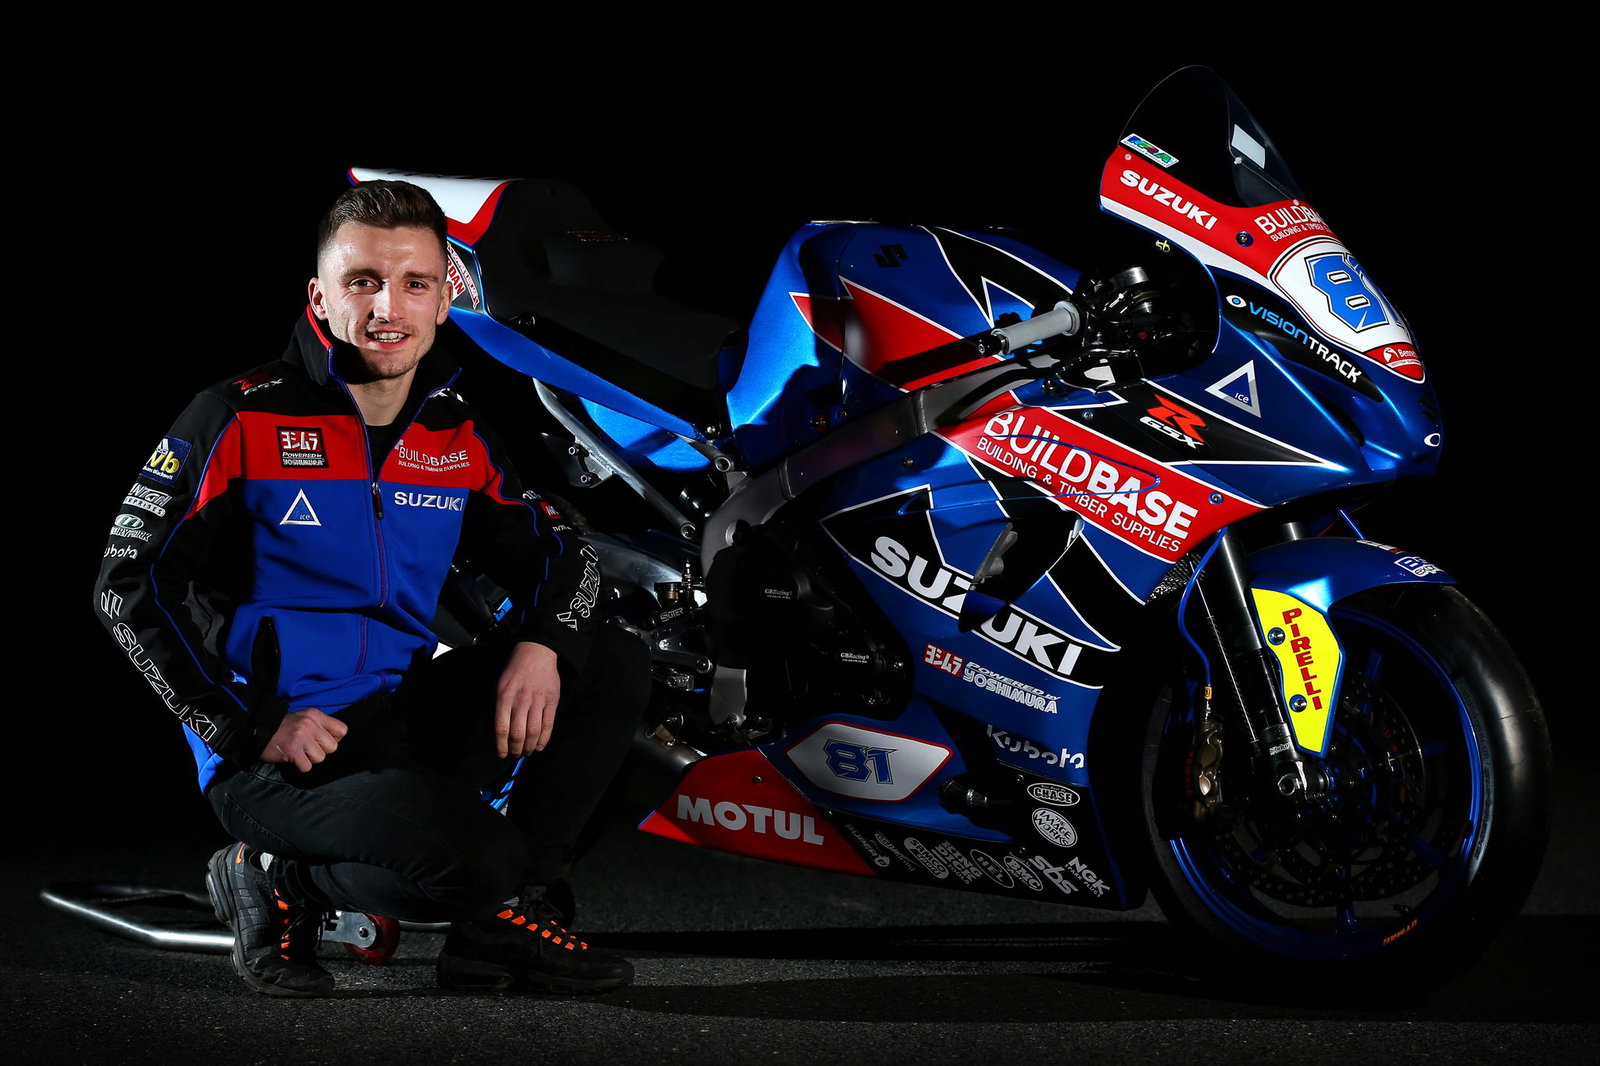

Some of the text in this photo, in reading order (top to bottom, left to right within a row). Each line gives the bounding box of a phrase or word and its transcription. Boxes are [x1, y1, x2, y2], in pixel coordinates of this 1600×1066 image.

[1119, 169, 1218, 231] SUZUKI
[1270, 225, 1302, 242] BUILDING
[1139, 416, 1204, 449] GSX
[398, 445, 469, 467] BUILDBASE
[983, 410, 1198, 540] BUILDBASE
[394, 491, 464, 511] SUZUKI
[976, 436, 1181, 552] BUILDING & TIMBER SUPPLIES
[1282, 607, 1323, 711] PIRELLI
[113, 622, 217, 742] SUZUKI
[962, 667, 1058, 714] YOSHIMURA
[965, 661, 1045, 695] POWERED
[823, 738, 898, 785] 81
[986, 724, 1085, 769] Kubota
[1033, 786, 1073, 804] CHASE
[677, 794, 824, 846] MOTUL
[1034, 814, 1069, 846] WORKS
[1039, 810, 1072, 840] IMAGE
[910, 839, 945, 873] SAMCO
[933, 845, 977, 882] DICK
[942, 839, 983, 877] KING
[976, 856, 1004, 883] HEL
[1007, 858, 1041, 889] BMC
[1067, 856, 1111, 895] NGK
